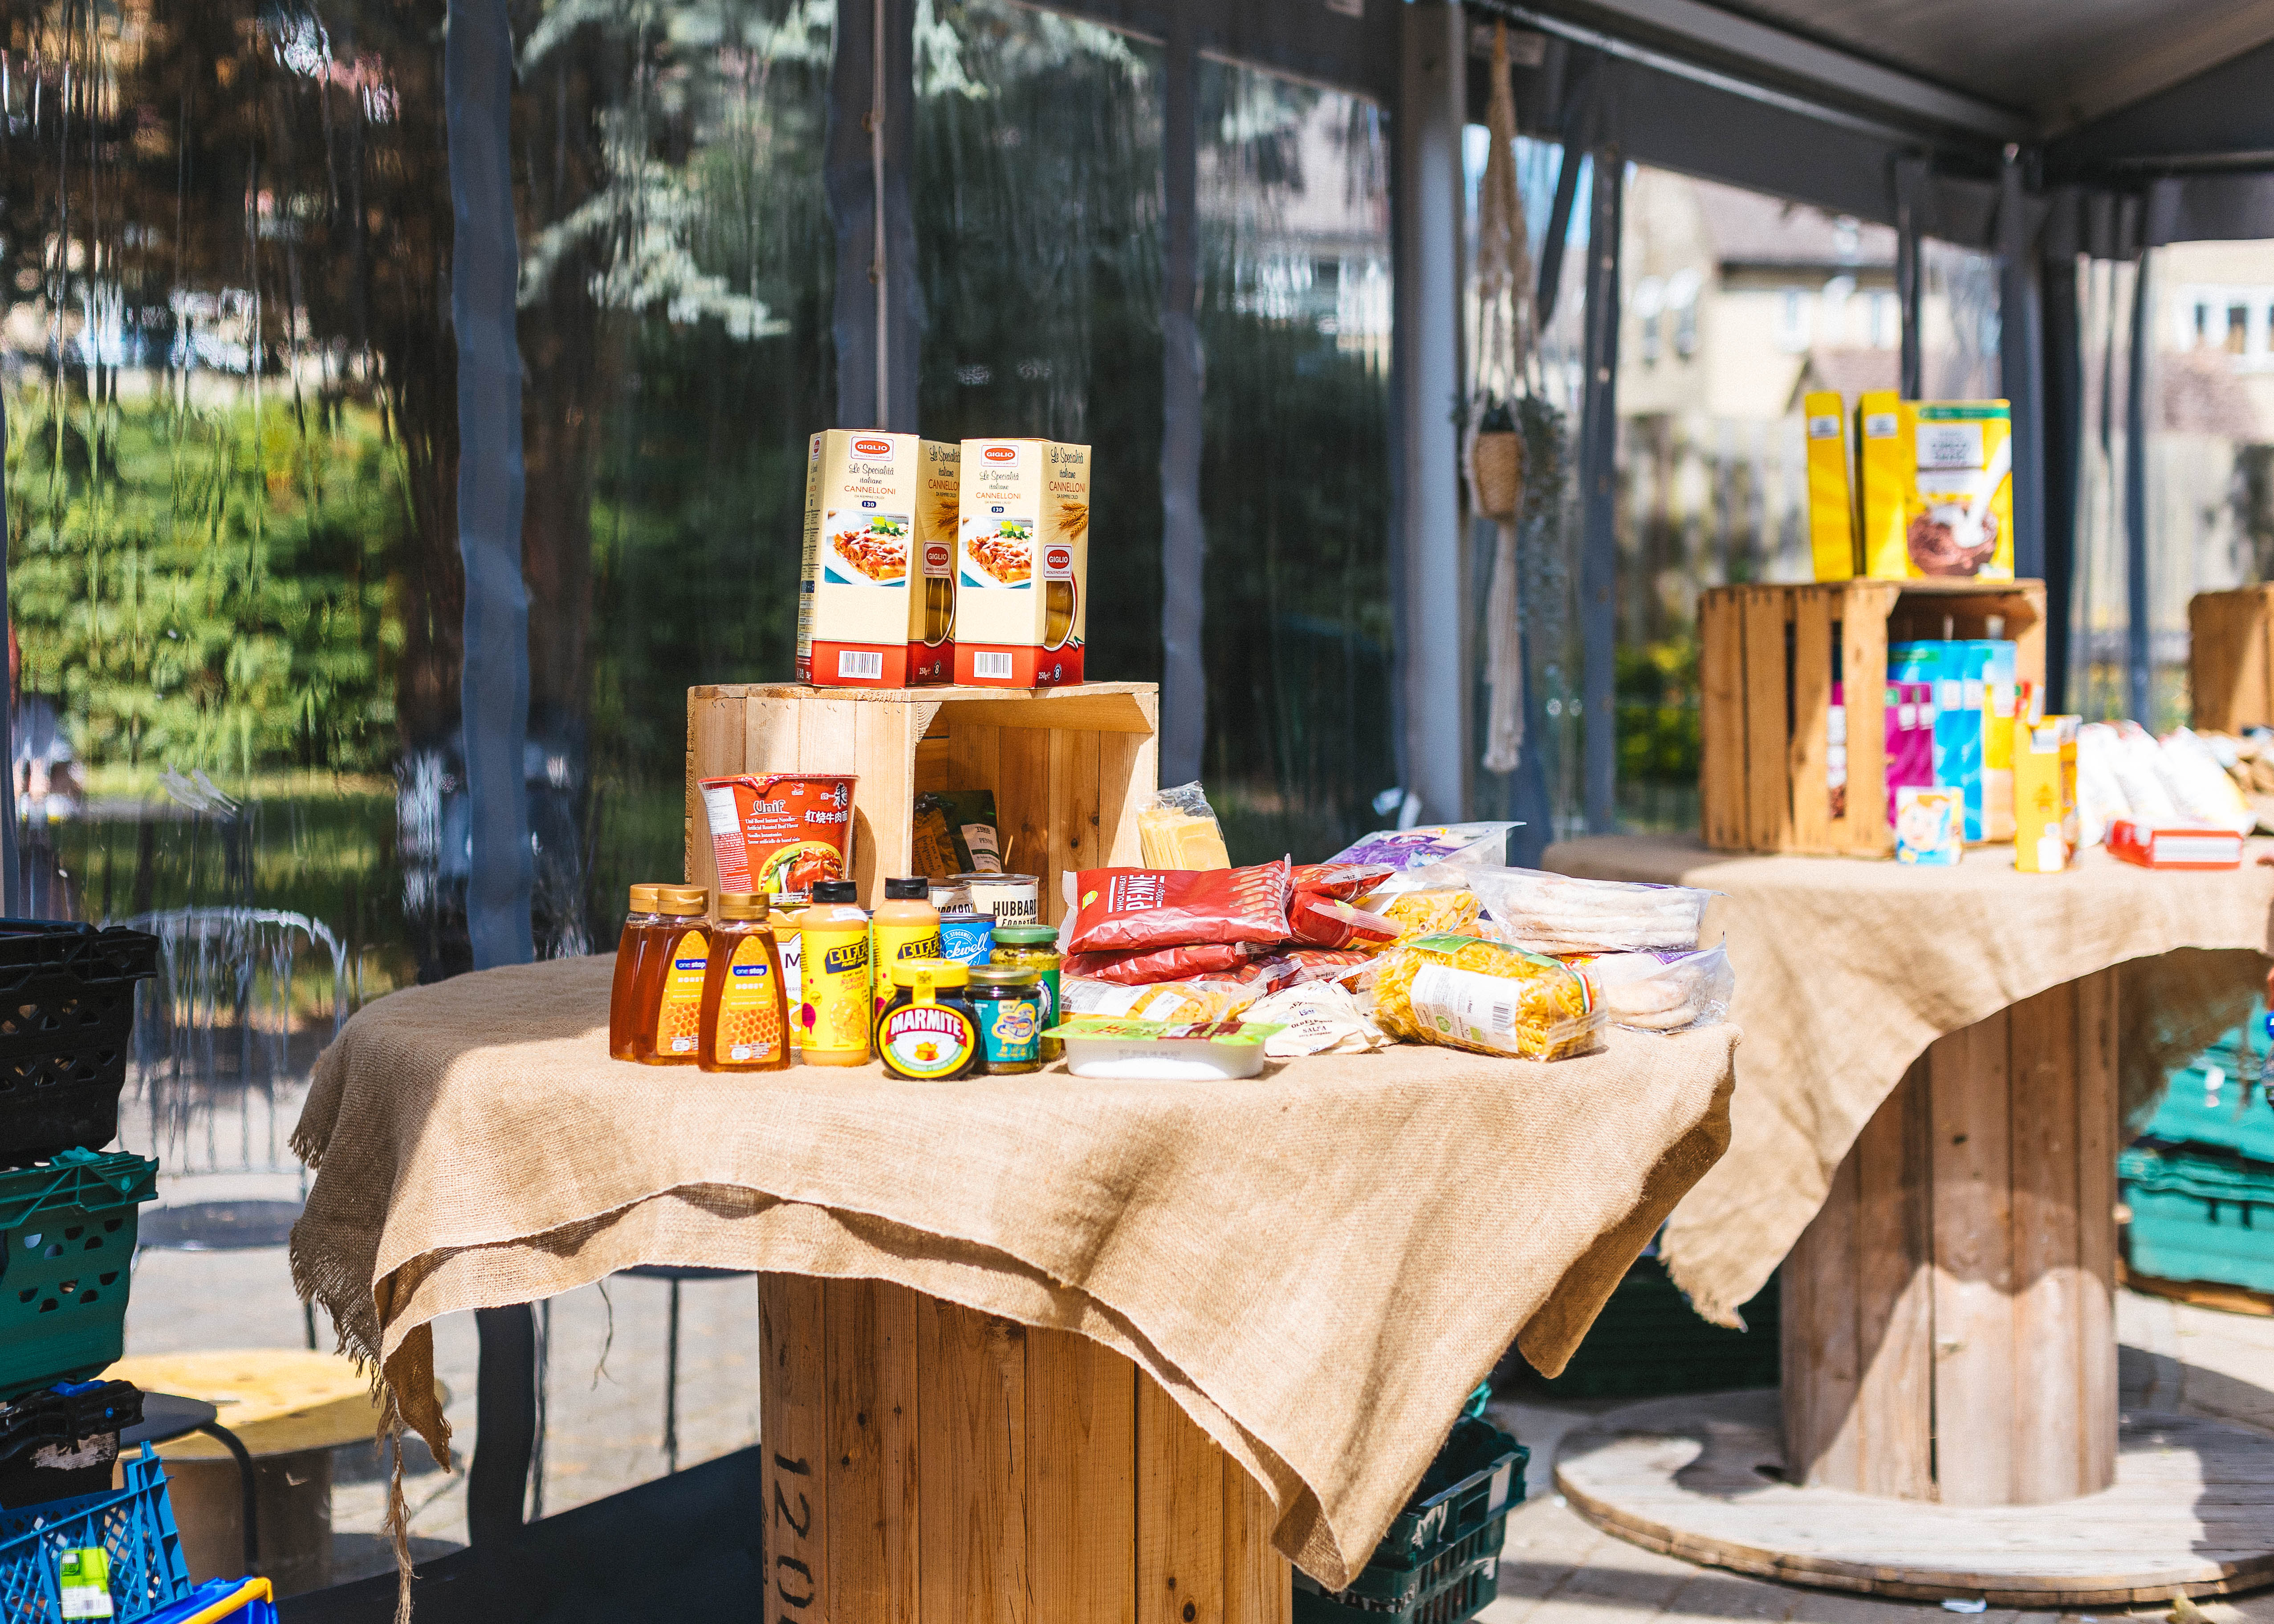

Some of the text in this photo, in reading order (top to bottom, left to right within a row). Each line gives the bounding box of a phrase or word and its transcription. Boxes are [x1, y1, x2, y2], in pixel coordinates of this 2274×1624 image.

[929, 445, 937, 461] Le
[1051, 447, 1083, 467] Le Specialità
[849, 463, 894, 476] Le Specialità
[939, 466, 954, 477] italiane
[1060, 467, 1076, 479] italiane
[979, 470, 1019, 483] Le Specialità
[844, 485, 895, 495] CANNELLONI
[928, 479, 959, 491] CANNELLO
[1049, 481, 1086, 493] CANNELLONI
[753, 799, 786, 813] Unif
[805, 809, 848, 824] 红烧牛肉面
[1116, 875, 1127, 912] WHOLEWHEAT
[1125, 874, 1157, 911] PENNE
[993, 898, 1037, 917] HUBBARD
[950, 931, 973, 942] STOCKWELL
[891, 1009, 961, 1035] MARMITE
